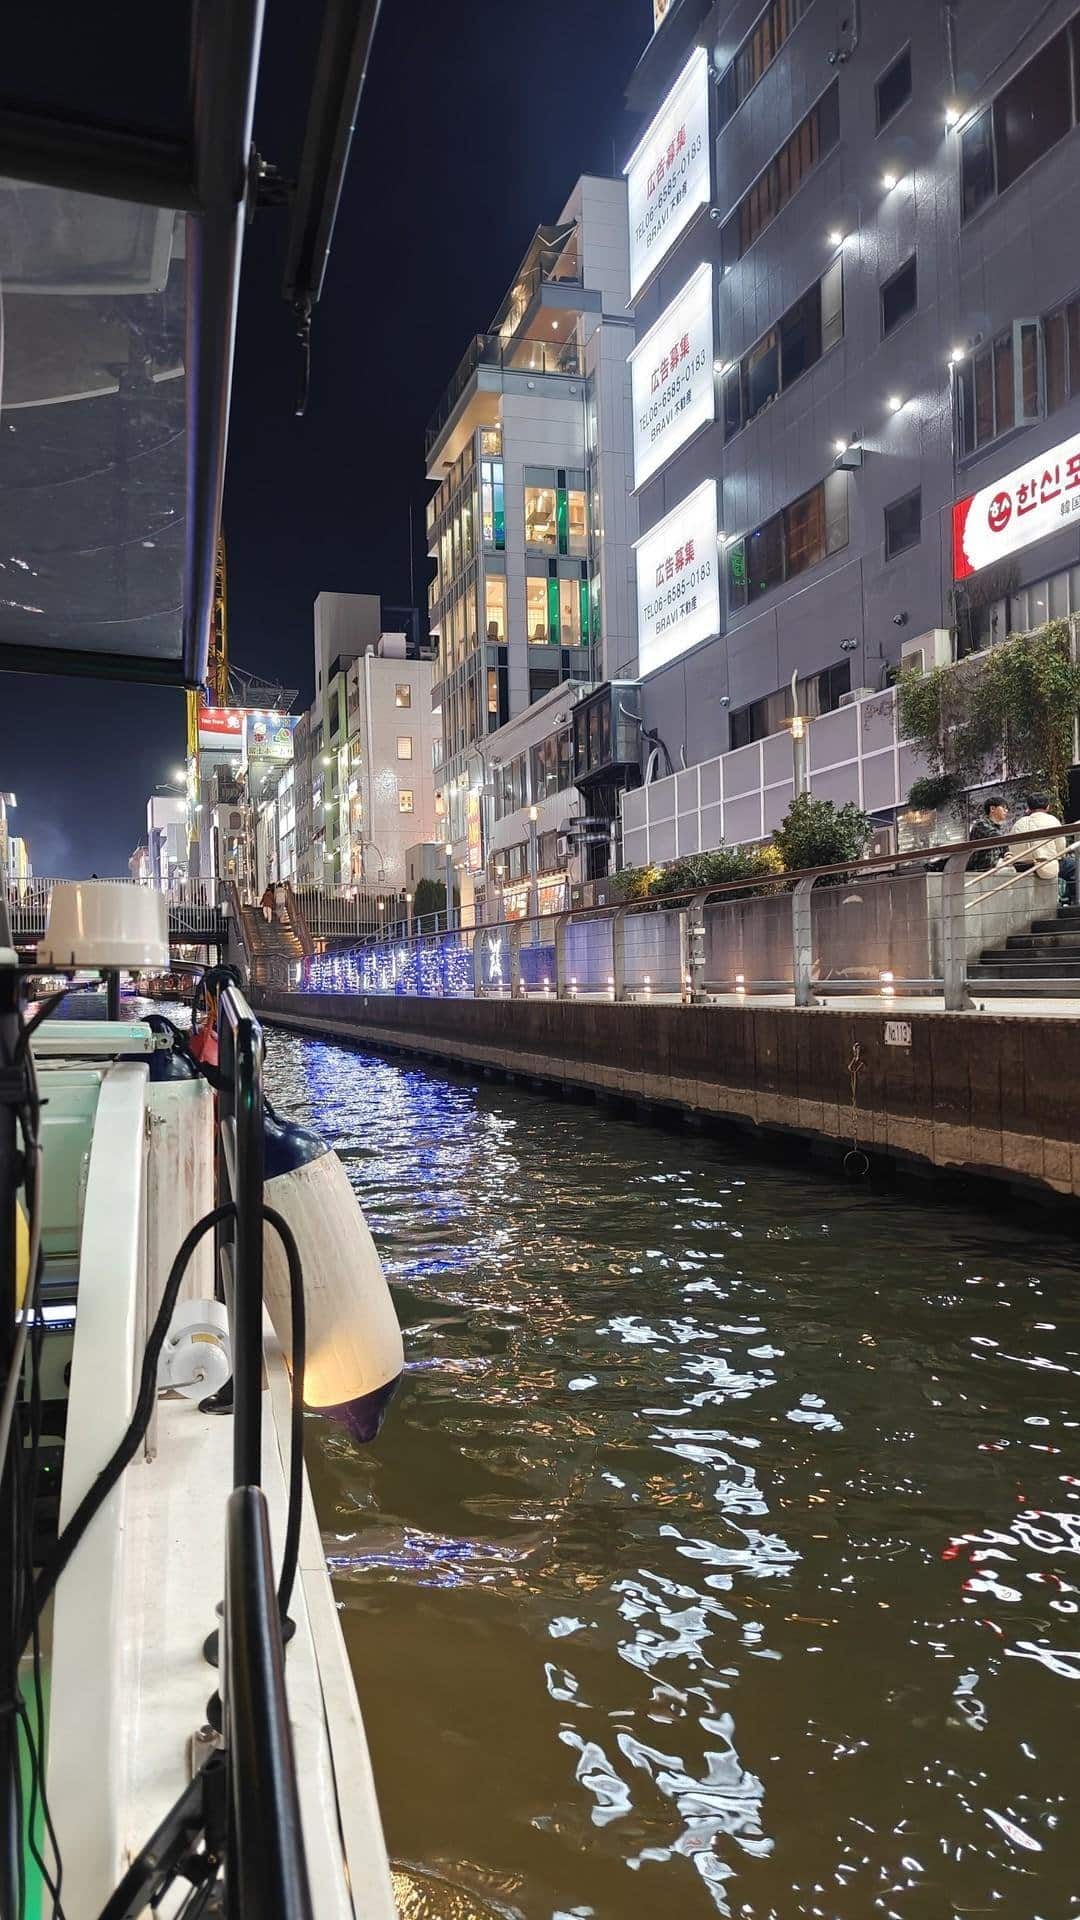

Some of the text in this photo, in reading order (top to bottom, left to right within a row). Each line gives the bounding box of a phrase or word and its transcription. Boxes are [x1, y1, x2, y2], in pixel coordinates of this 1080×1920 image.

[646, 207, 669, 248] BRAVI
[651, 333, 690, 395] 広告募集
[651, 408, 673, 442] BRAVI
[655, 539, 695, 588] 広告募集
[656, 609, 679, 635] BRAVI
